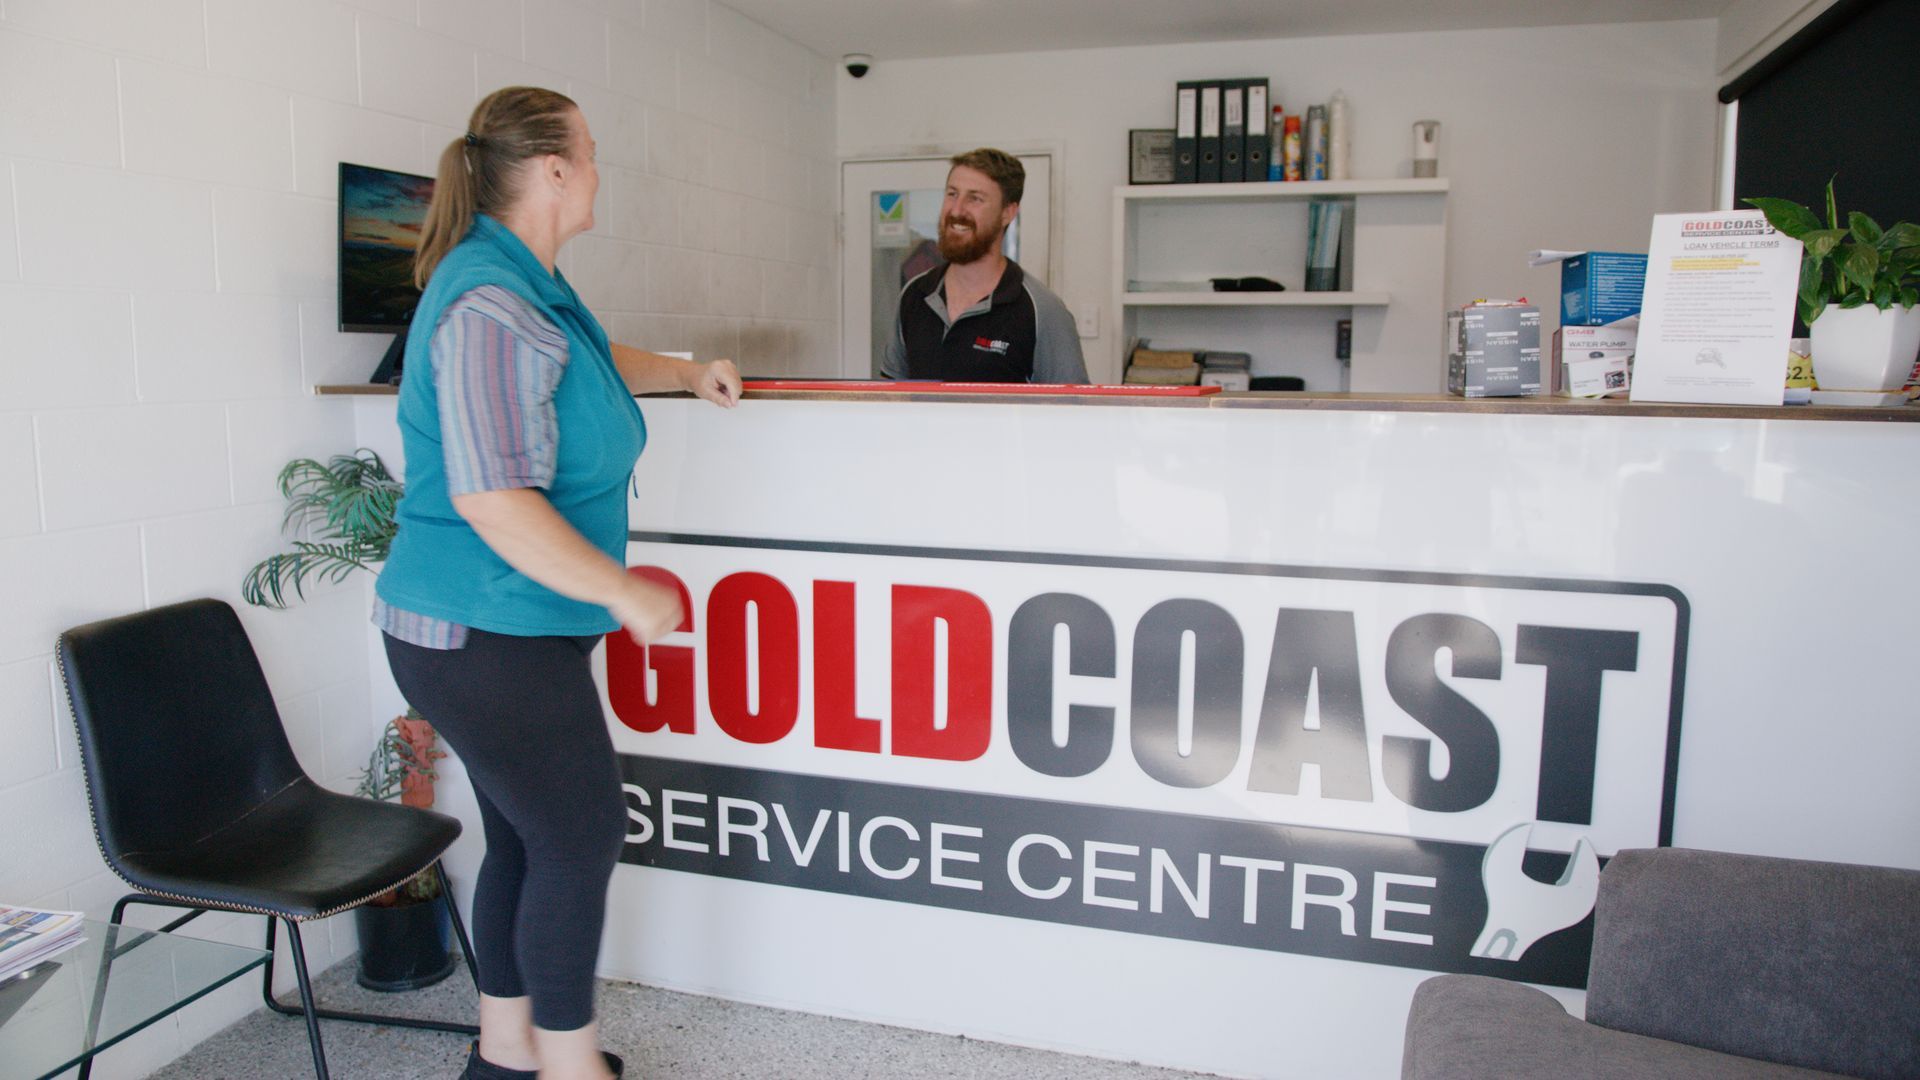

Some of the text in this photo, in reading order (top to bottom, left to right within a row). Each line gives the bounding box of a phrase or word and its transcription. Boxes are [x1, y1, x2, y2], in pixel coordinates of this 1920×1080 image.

[1710, 241, 1746, 249] VEHICLE
[1749, 240, 1780, 248] TERMS
[606, 565, 1639, 824] GOLDCOAST
[622, 784, 1437, 946] SERVICE CENTRE
